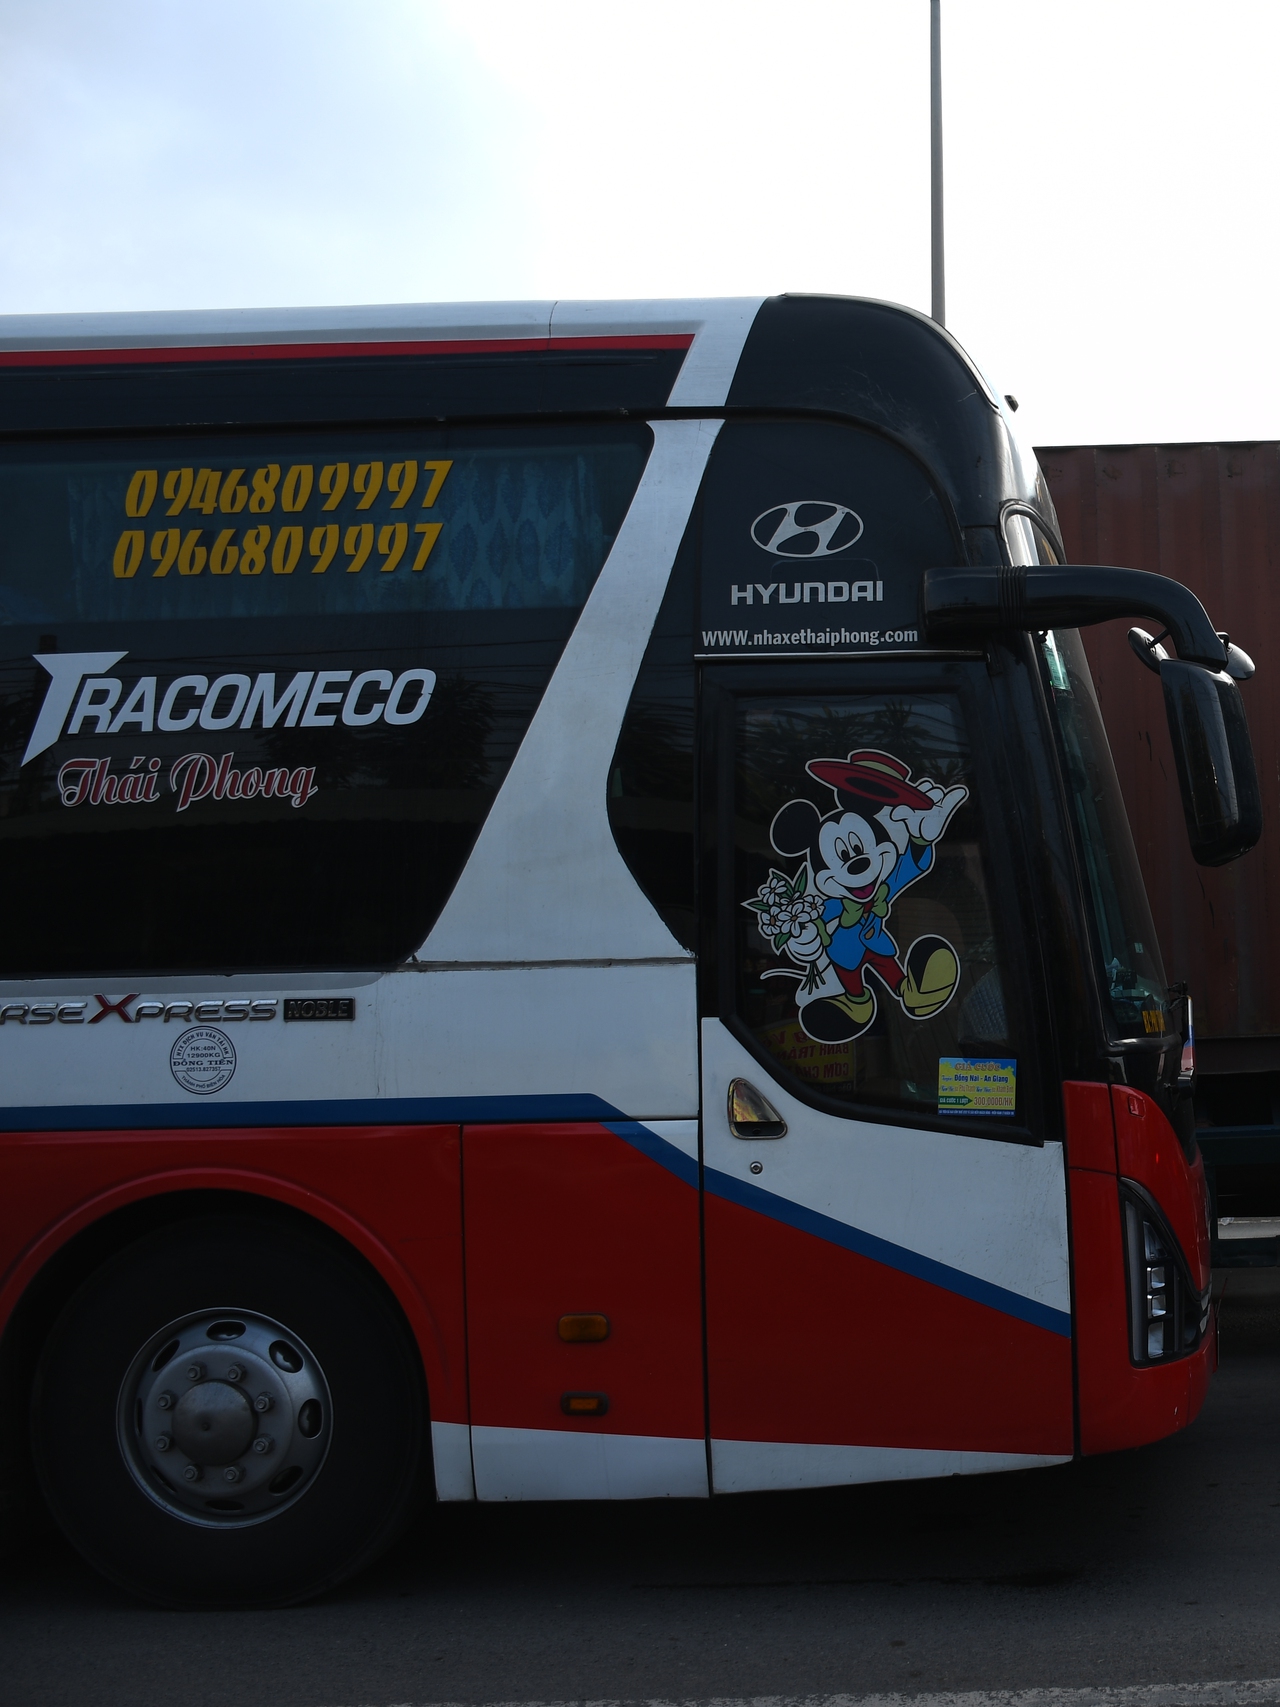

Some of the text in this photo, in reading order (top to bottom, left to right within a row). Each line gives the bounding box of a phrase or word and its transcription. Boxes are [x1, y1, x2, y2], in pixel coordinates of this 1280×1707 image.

[126, 460, 453, 518] 0946809997
[112, 522, 443, 579] 0966809997
[731, 580, 883, 605] HYUNDAI
[21, 651, 437, 767] TRACOMECO
[57, 751, 318, 812] Thái Phong
[287, 999, 350, 1019] NOBLE
[969, 1074, 980, 1082] Nai
[983, 1074, 991, 1082] An
[992, 1075, 1009, 1084] Giang
